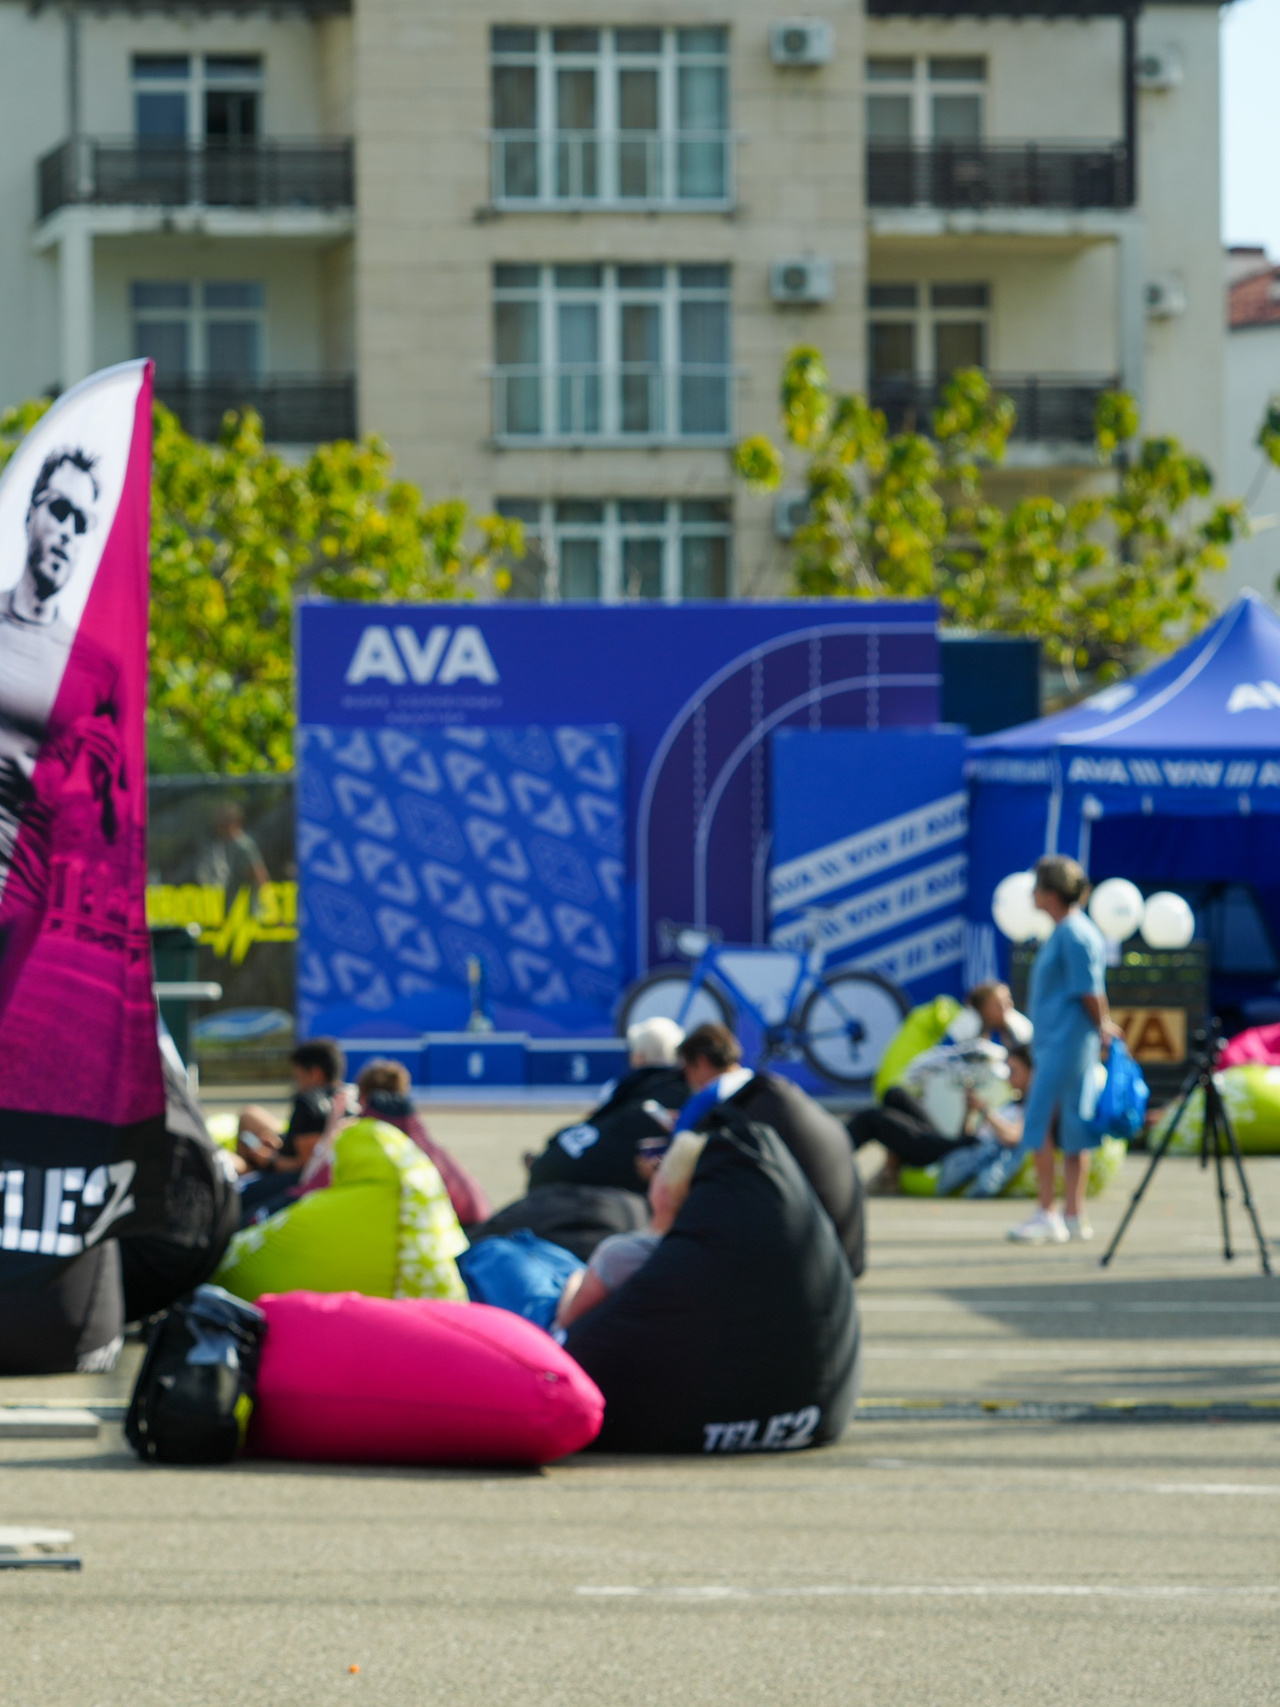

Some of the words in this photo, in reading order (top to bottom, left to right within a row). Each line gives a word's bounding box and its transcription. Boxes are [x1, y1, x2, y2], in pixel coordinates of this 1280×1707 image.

[345, 624, 501, 686] AVA
[1068, 757, 1130, 786] AVA
[695, 1404, 821, 1452] TELE2
